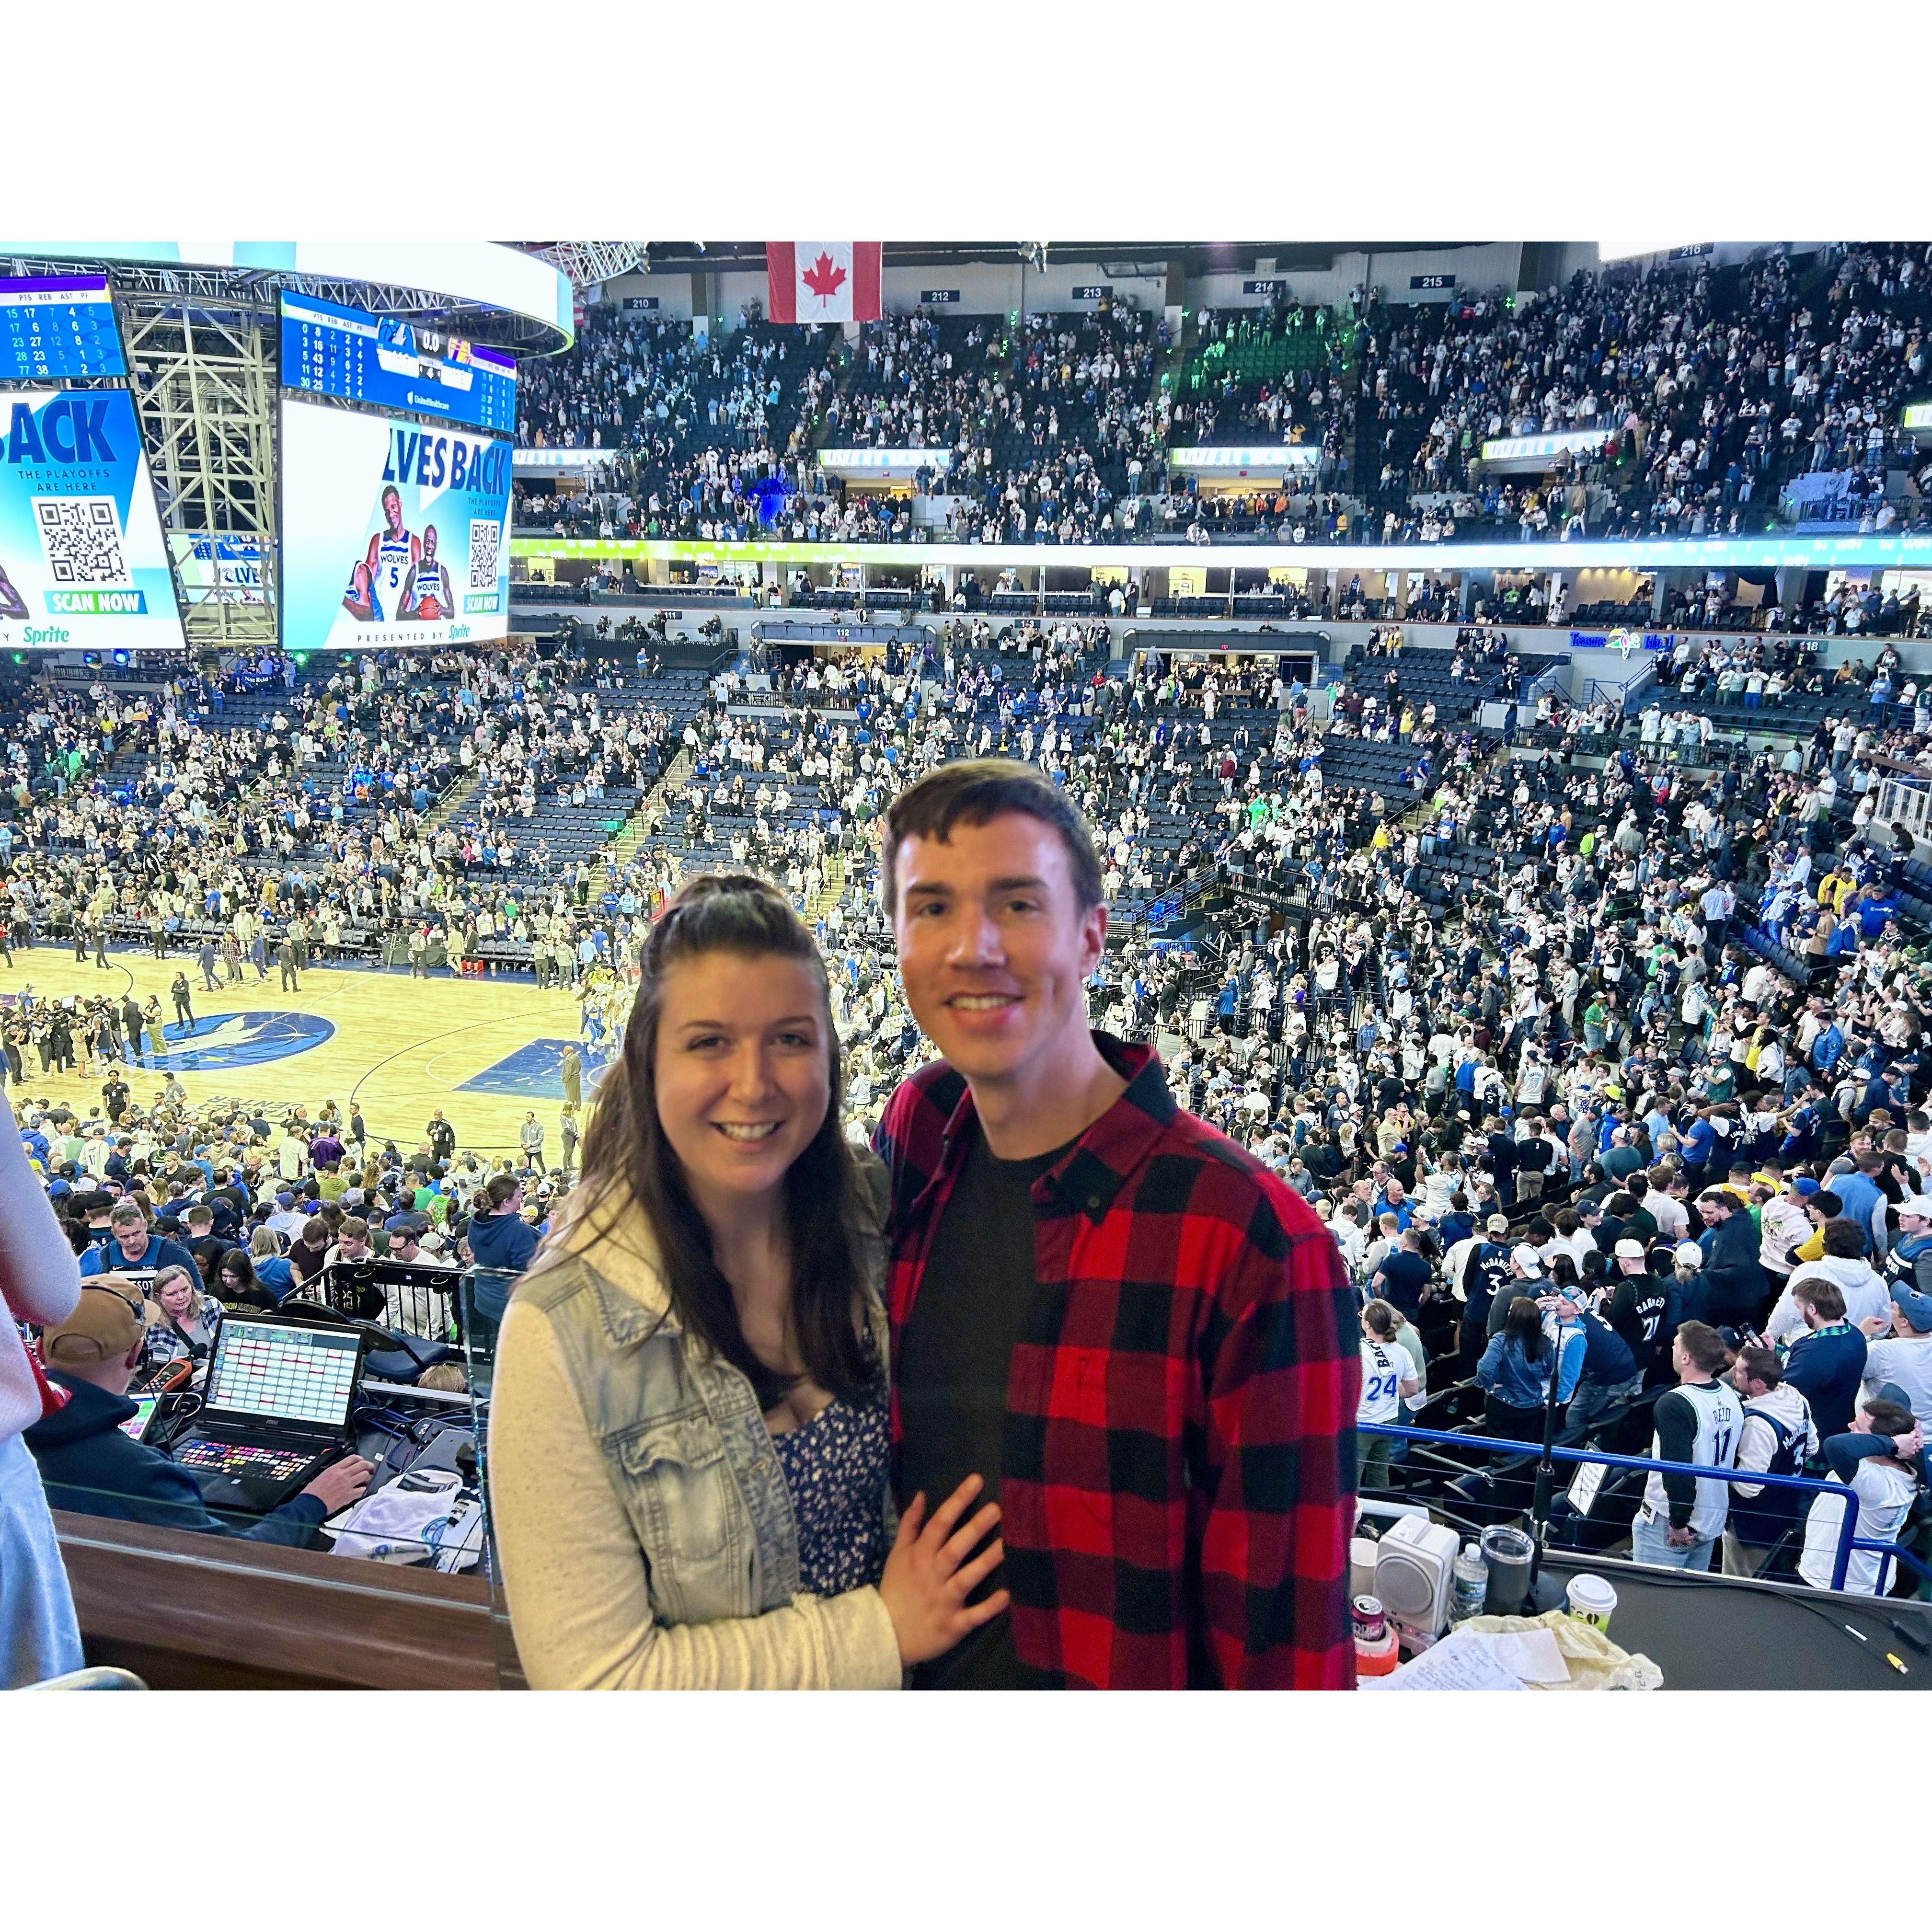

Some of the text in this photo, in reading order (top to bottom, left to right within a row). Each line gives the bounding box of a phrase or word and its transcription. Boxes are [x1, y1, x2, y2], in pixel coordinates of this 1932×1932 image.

[1681, 246, 1700, 256] 216
[1254, 282, 1274, 293] 214
[1422, 276, 1442, 288] 215
[932, 292, 949, 302] 212
[1083, 288, 1102, 298] 213
[633, 299, 649, 308] 210
[6, 307, 94, 318] 15 17 7 4 5
[10, 321, 97, 333] 17 6 8 6 3
[328, 317, 337, 325] REB
[12, 335, 100, 347] 23 27 12 8 2
[302, 323, 363, 347] 0 8 2 2 4
[422, 331, 439, 352] 0.0
[15, 349, 104, 361] 28 23 5 1 3
[302, 337, 363, 360] 3 16 11 3 4
[18, 363, 106, 375] 77 38 1 2 3
[302, 351, 363, 373] 5 43 9 6 2
[301, 364, 363, 386] 11 12 4 2 2
[300, 376, 363, 398] 30 25 7 3 4
[0, 400, 117, 464] ACK
[18, 469, 110, 479] THE PLAYOFFS
[449, 439, 507, 495] BACK
[37, 482, 96, 492] ARE HERE
[479, 498, 501, 508] PLAYOFFS
[380, 554, 408, 565] WOLVES
[390, 567, 398, 588] 5
[417, 582, 440, 592] WOLVES
[52, 593, 139, 612] SCAN NOW
[466, 595, 498, 611] SCAN NOW
[23, 626, 69, 645] Sprite
[357, 623, 470, 643] PRESENTED BY Sprite
[1570, 631, 1606, 647] Treasure
[1248, 900, 1269, 910] EXUS
[1487, 1095, 1494, 1104] 5
[1485, 1273, 1503, 1296] 3
[1641, 1313, 1660, 1342] 21
[1366, 1374, 1397, 1401] 24
[1712, 1408, 1731, 1425] REID
[1712, 1425, 1733, 1467] 11
[1793, 1442, 1806, 1477] 3
